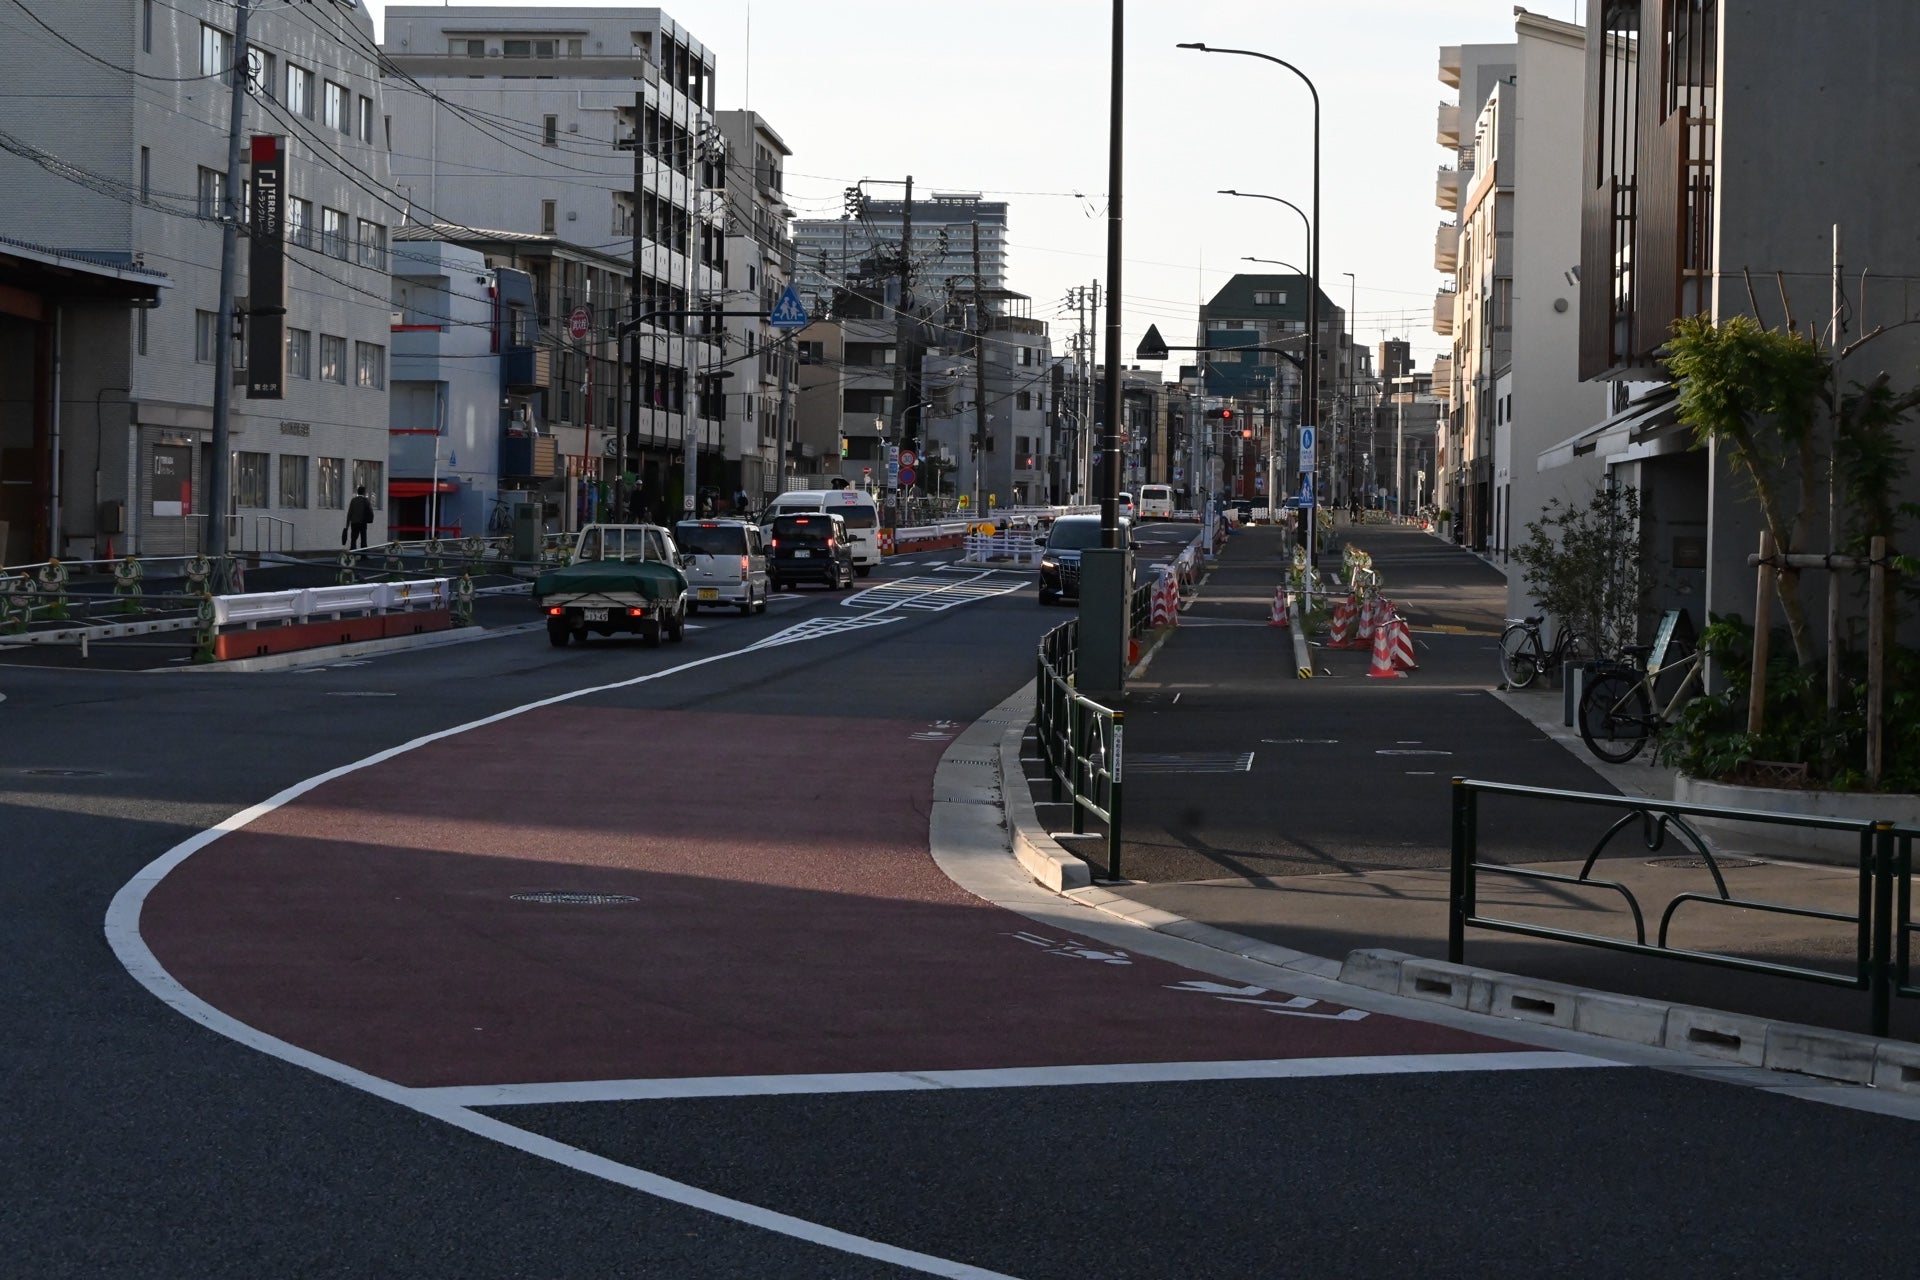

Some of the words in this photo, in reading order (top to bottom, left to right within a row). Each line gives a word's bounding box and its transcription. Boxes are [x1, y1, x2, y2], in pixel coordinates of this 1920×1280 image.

[267, 188, 276, 234] TERRADA
[253, 383, 277, 391] 東北沢
[903, 455, 912, 463] 30
